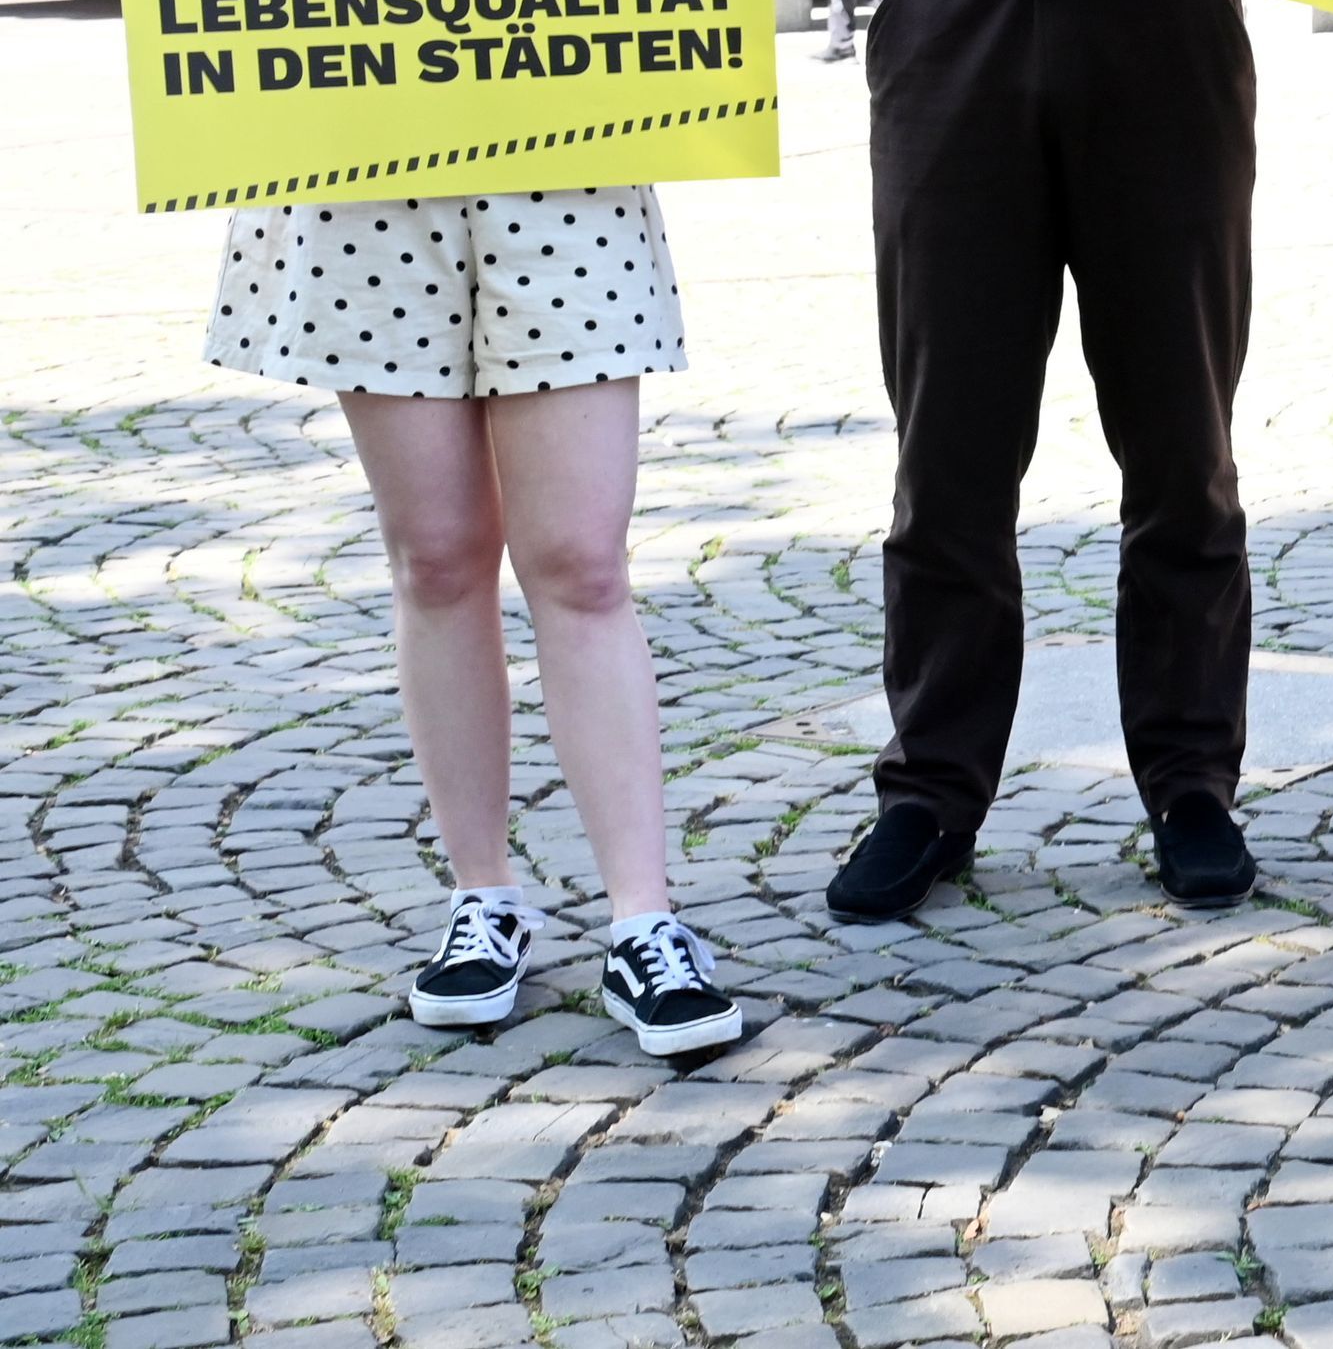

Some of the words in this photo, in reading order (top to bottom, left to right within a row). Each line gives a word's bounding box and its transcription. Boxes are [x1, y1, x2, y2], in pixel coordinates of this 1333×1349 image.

[163, 50, 235, 96] IN
[257, 42, 397, 91] DEN
[417, 26, 743, 83] STÄDTEN!
